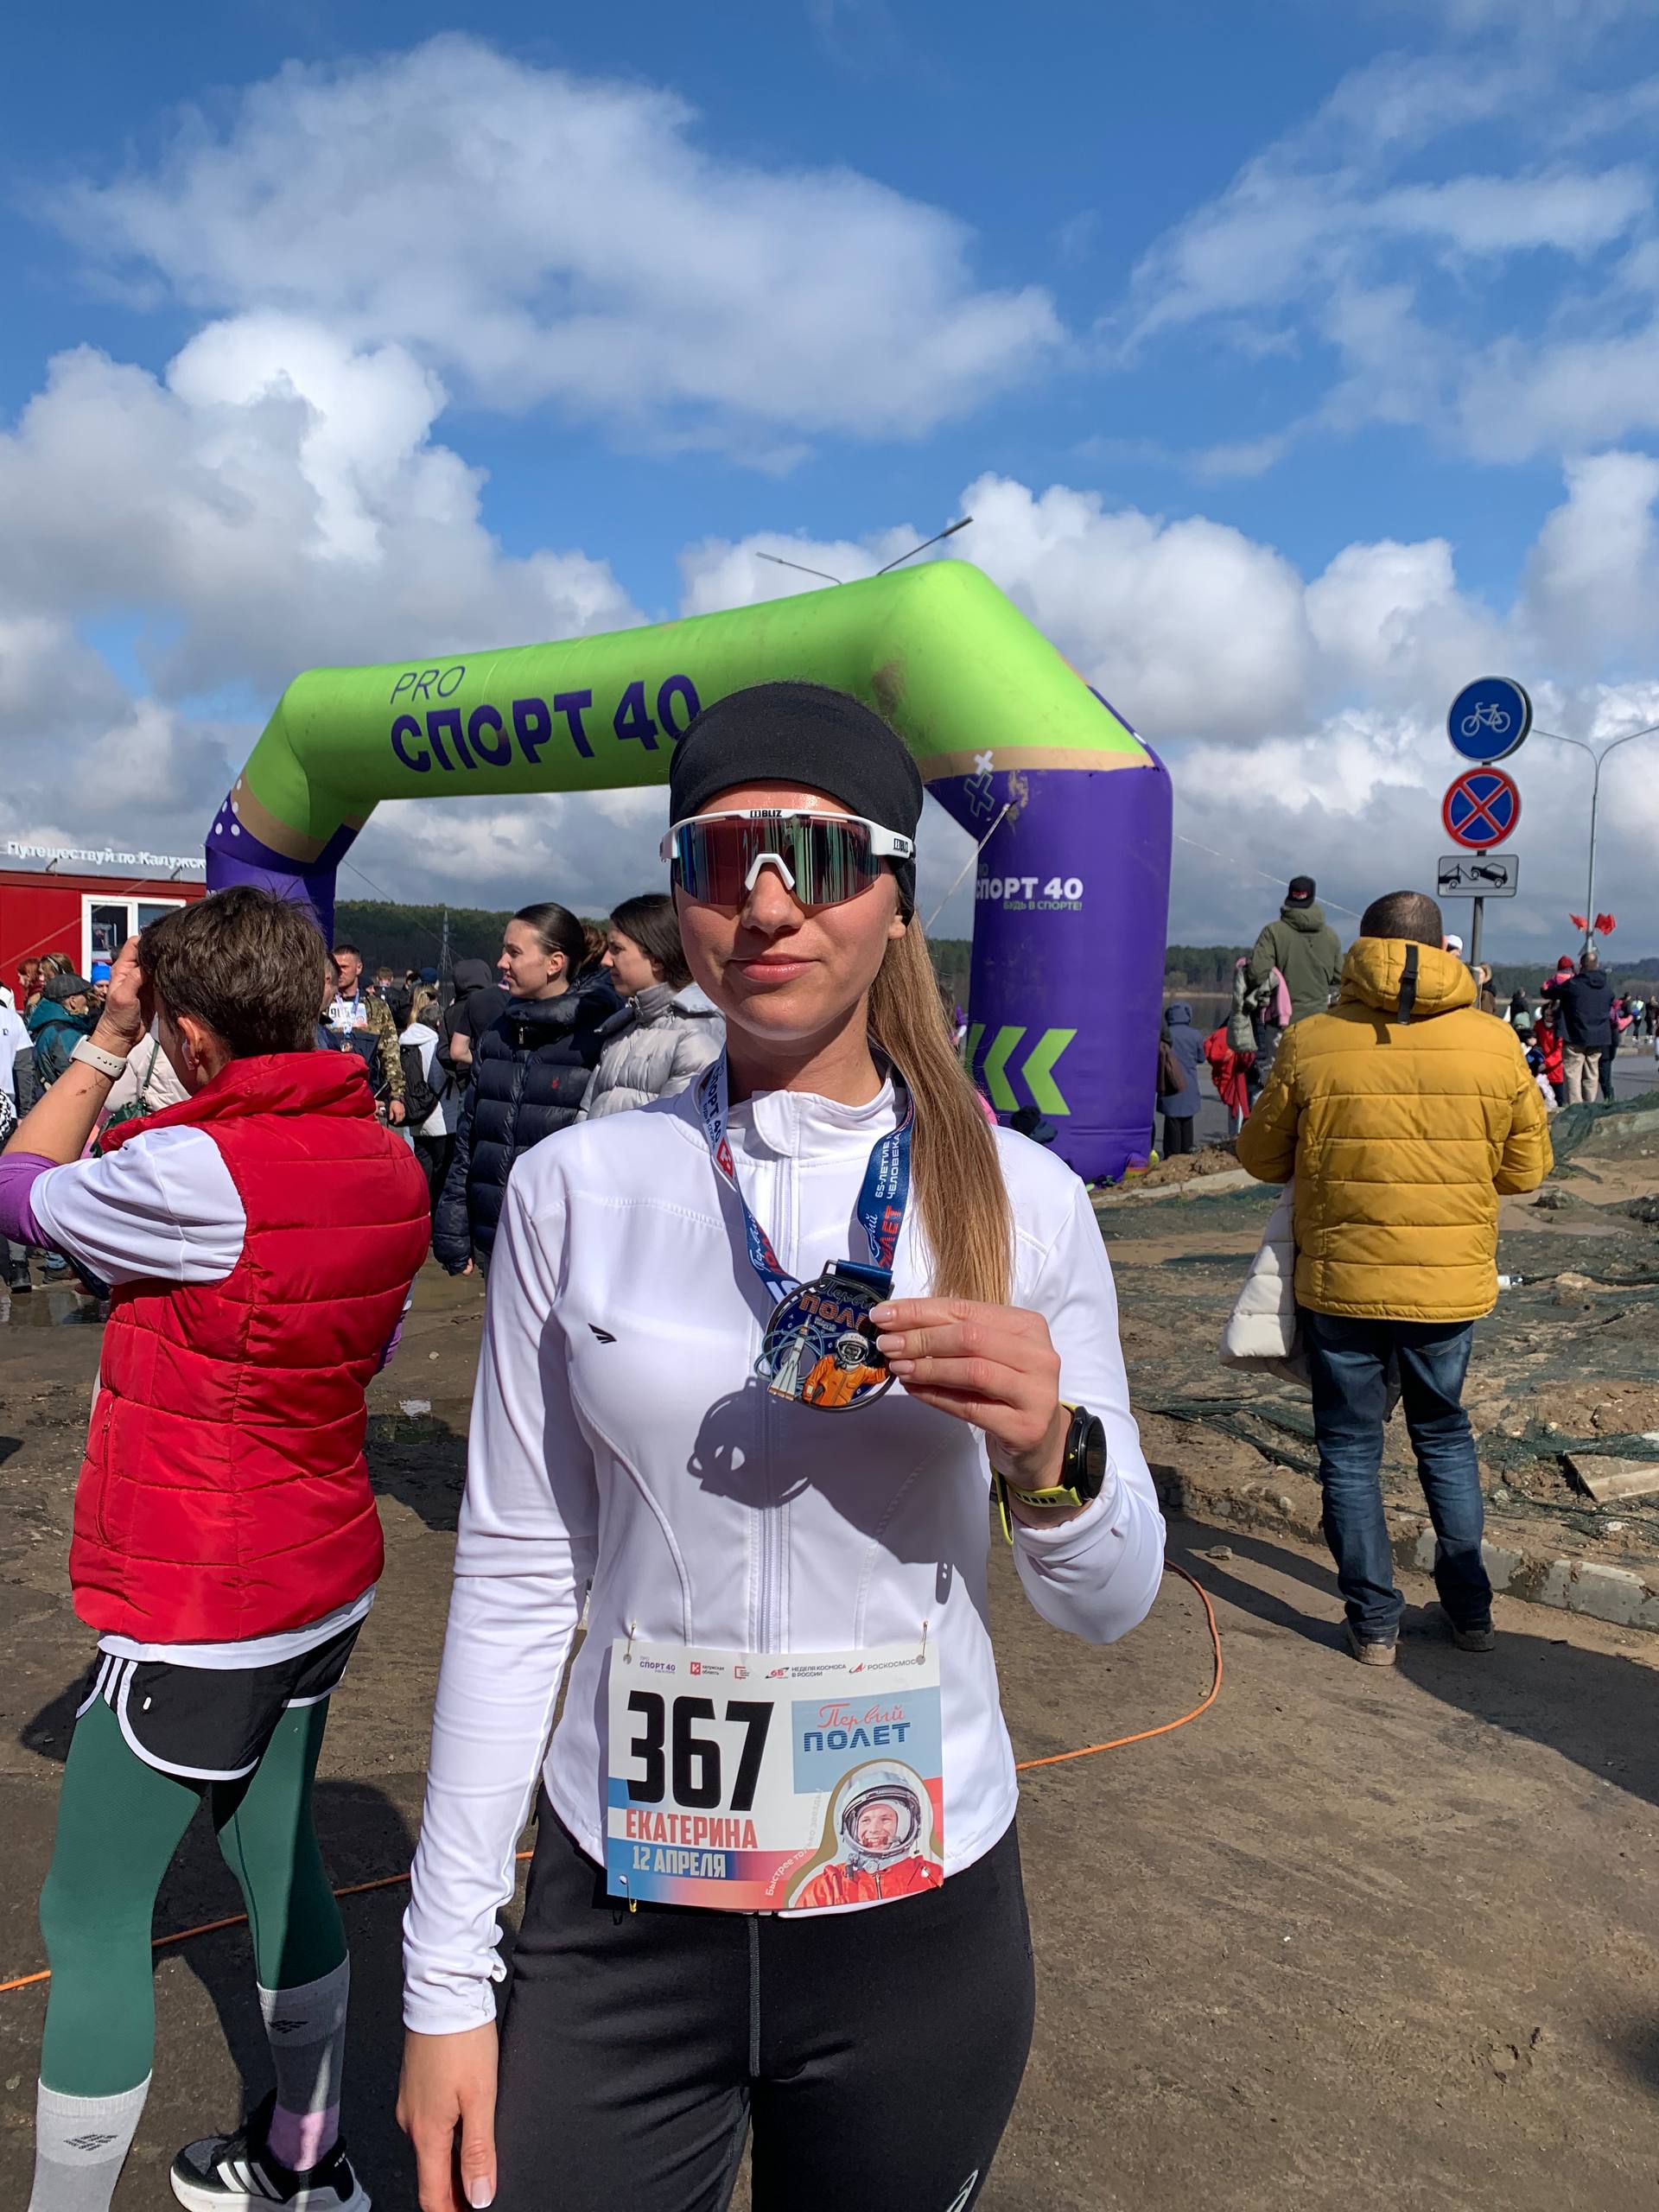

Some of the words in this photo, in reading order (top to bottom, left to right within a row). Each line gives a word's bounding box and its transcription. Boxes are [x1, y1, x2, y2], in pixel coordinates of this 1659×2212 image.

[390, 665, 466, 705] PRO
[391, 689, 595, 773] СПОРТ
[613, 674, 702, 751] 40
[7, 841, 114, 867] Путешествуй
[118, 852, 137, 865] по
[1043, 876, 1084, 900] 40
[874, 1140, 891, 1199] 65-ЛЕТИЕ
[887, 1132, 902, 1200] ЧЕЛОВЕКА
[639, 1660, 665, 1670] СПОРТ
[665, 1663, 677, 1672] 40
[867, 1658, 917, 1671] РОСКОСМОС
[817, 1702, 904, 1732] Первый
[626, 1689, 775, 1812] 367
[804, 1721, 912, 1753] ПОЛЕТ
[626, 1808, 759, 1849] ЕКАТЕРИНА
[632, 1845, 651, 1871] 12
[653, 1848, 727, 1878] АПРЕЛЯ
[765, 1858, 795, 1897] Быстрее
